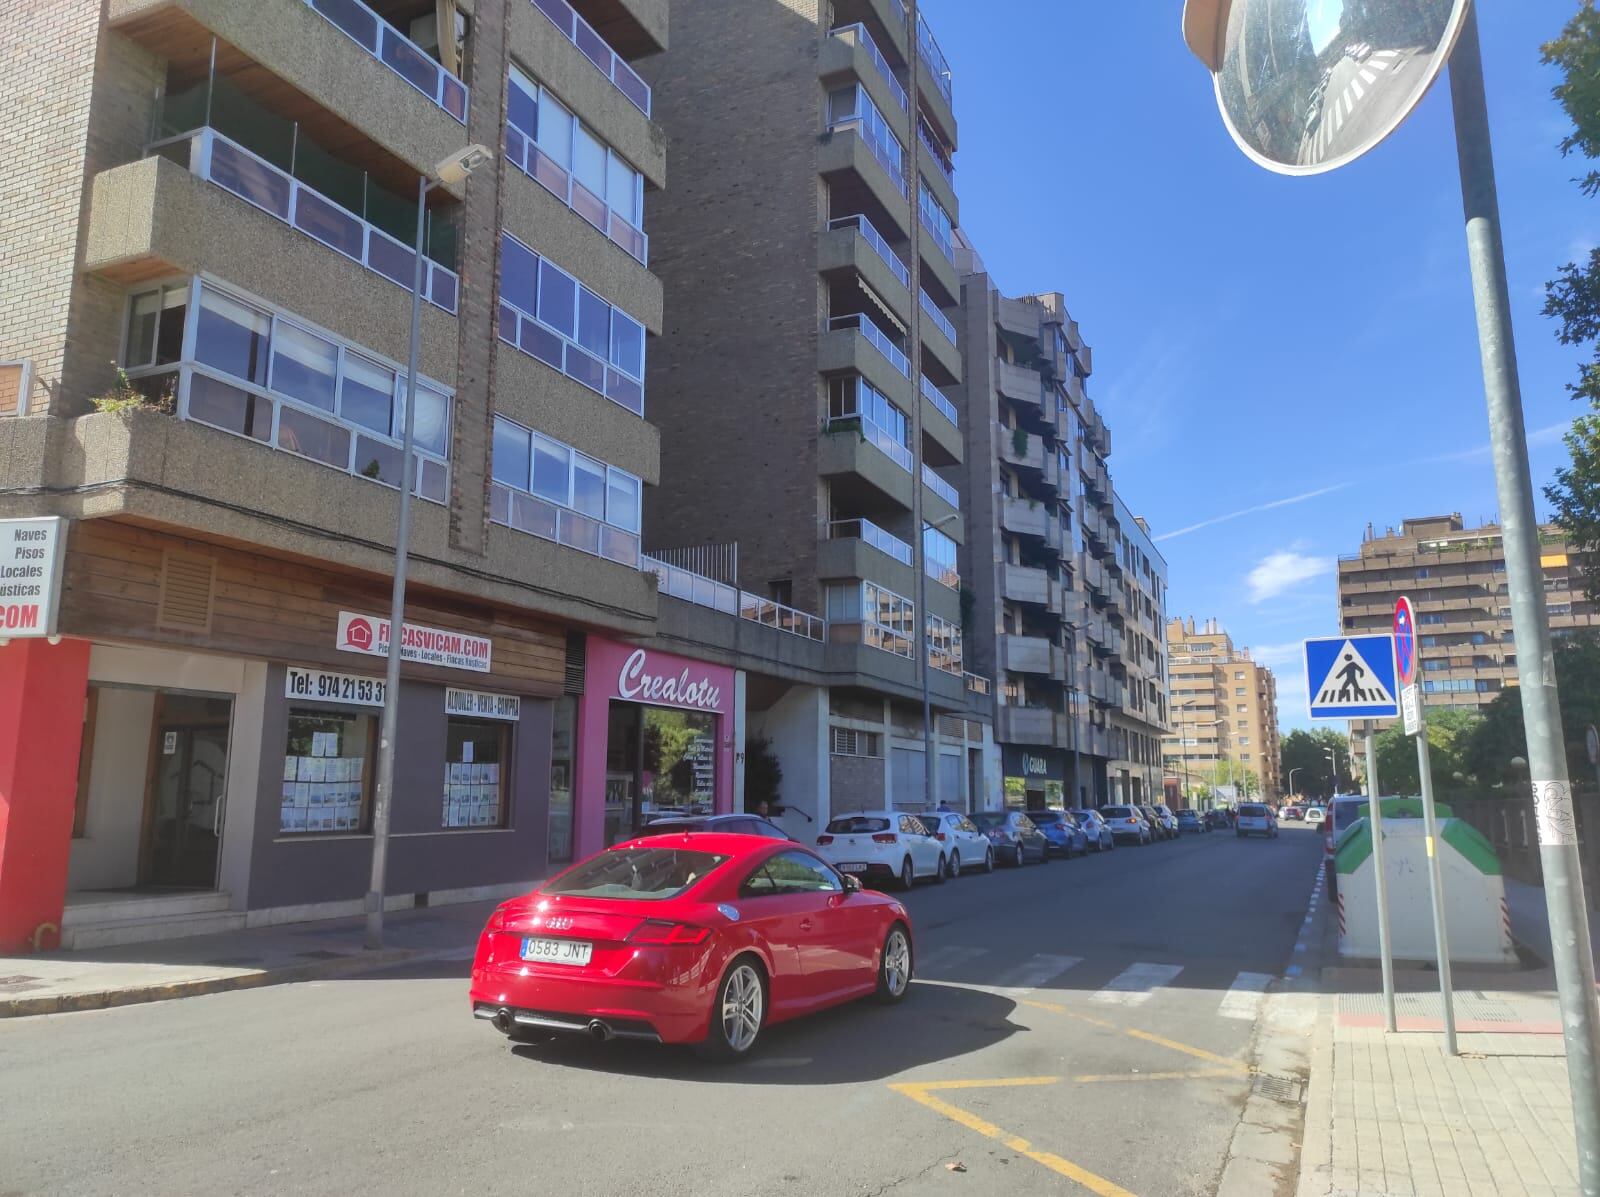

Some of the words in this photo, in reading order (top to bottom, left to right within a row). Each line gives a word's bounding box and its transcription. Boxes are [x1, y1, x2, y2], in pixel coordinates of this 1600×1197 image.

[14, 528, 48, 541] Naves
[14, 546, 45, 559] Pisos
[0, 565, 43, 578] Locales
[378, 623, 489, 659] FICASVICAM.COM
[421, 651, 443, 663] Locales
[446, 654, 464, 666] Fincas
[290, 671, 312, 695] Tel:
[318, 674, 339, 698] 974
[342, 677, 356, 700] 21
[358, 680, 372, 702] 53
[618, 648, 721, 708] Crealotu
[447, 690, 474, 712] ALQUILER
[477, 694, 494, 713] VENTA
[497, 697, 519, 717] COMPRA
[528, 940, 559, 957] 0583
[563, 943, 589, 960] JNT
